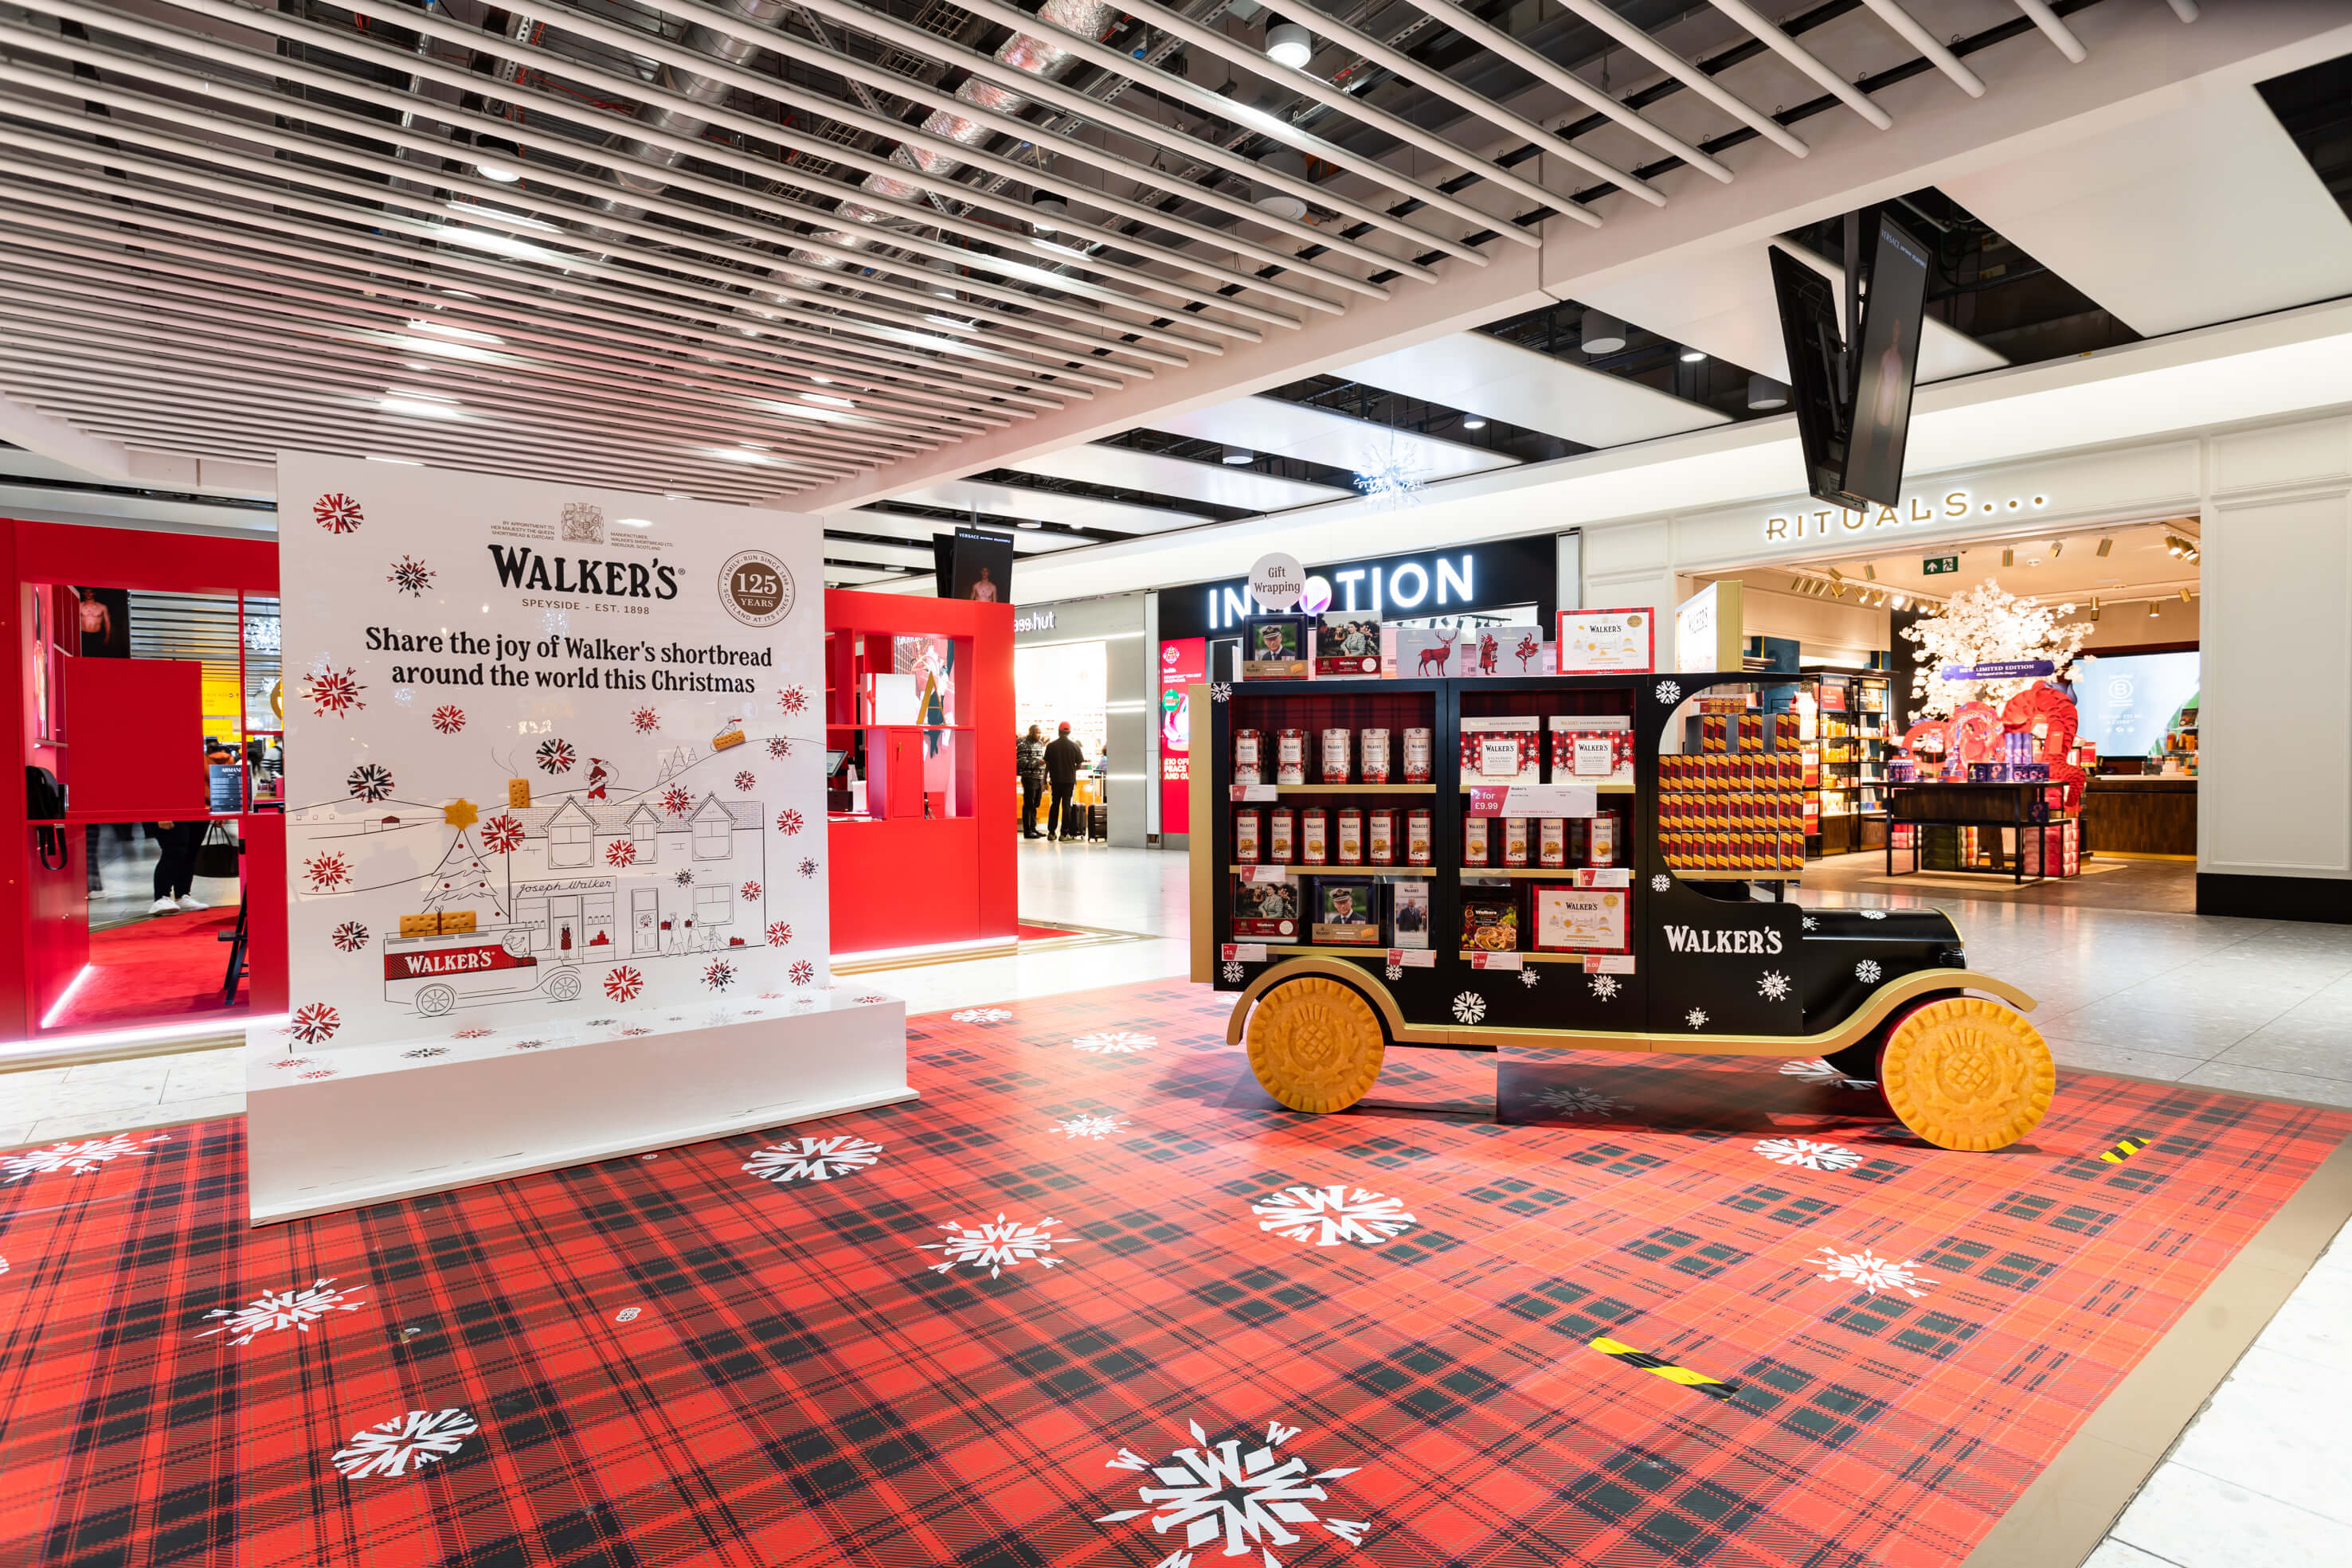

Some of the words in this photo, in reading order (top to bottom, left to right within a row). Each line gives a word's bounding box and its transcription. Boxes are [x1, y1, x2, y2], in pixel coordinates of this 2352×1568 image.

[1268, 565, 1286, 578] Gift
[737, 573, 777, 595] 125
[1254, 581, 1301, 595] Wrapping
[522, 598, 580, 611] SPEYSIDE
[595, 603, 620, 613] EST.
[624, 605, 650, 615] 1898
[723, 588, 751, 620] SCOTLAND
[740, 598, 773, 608] YEARS
[1033, 612, 1054, 630] hut
[1589, 624, 1622, 633] WALKER'S
[365, 626, 444, 653] Share
[450, 632, 491, 655] the
[495, 634, 531, 663] joy
[537, 635, 561, 658] of
[564, 637, 656, 663] Walker's
[661, 643, 773, 667] shortbread
[391, 663, 484, 686] around
[490, 664, 530, 687] the
[535, 667, 599, 690] world
[605, 668, 647, 690] this
[652, 670, 755, 694] Christmas
[517, 884, 565, 897] Joseph
[568, 879, 612, 890] Walker
[1565, 901, 1599, 911] WALKER'S
[1662, 925, 1783, 955] WALKER'S
[405, 948, 492, 975] WALKER'S
